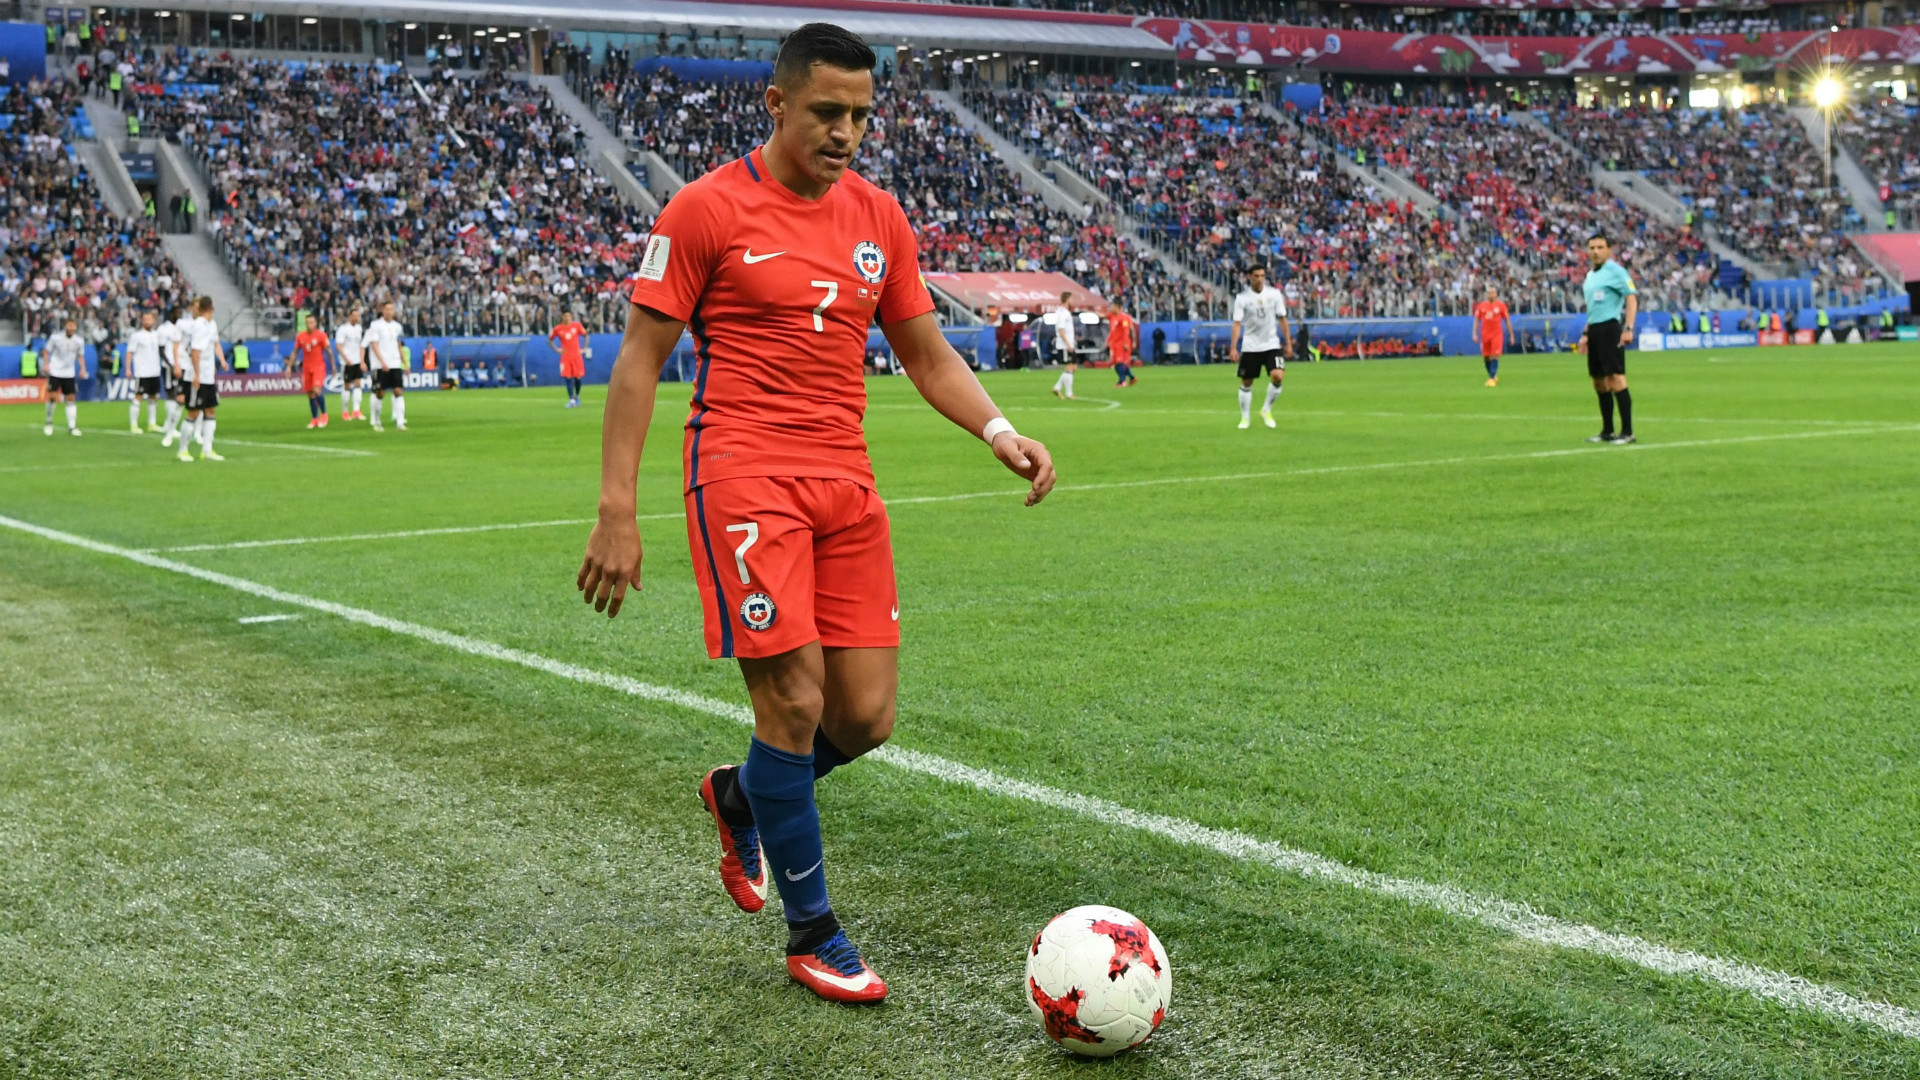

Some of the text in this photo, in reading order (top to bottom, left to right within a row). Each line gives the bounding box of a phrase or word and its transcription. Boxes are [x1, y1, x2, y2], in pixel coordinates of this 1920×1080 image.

[811, 280, 838, 332] 7
[1256, 307, 1266, 319] 13
[217, 377, 302, 392] TAR AIRWAYS
[726, 522, 759, 585] 7
